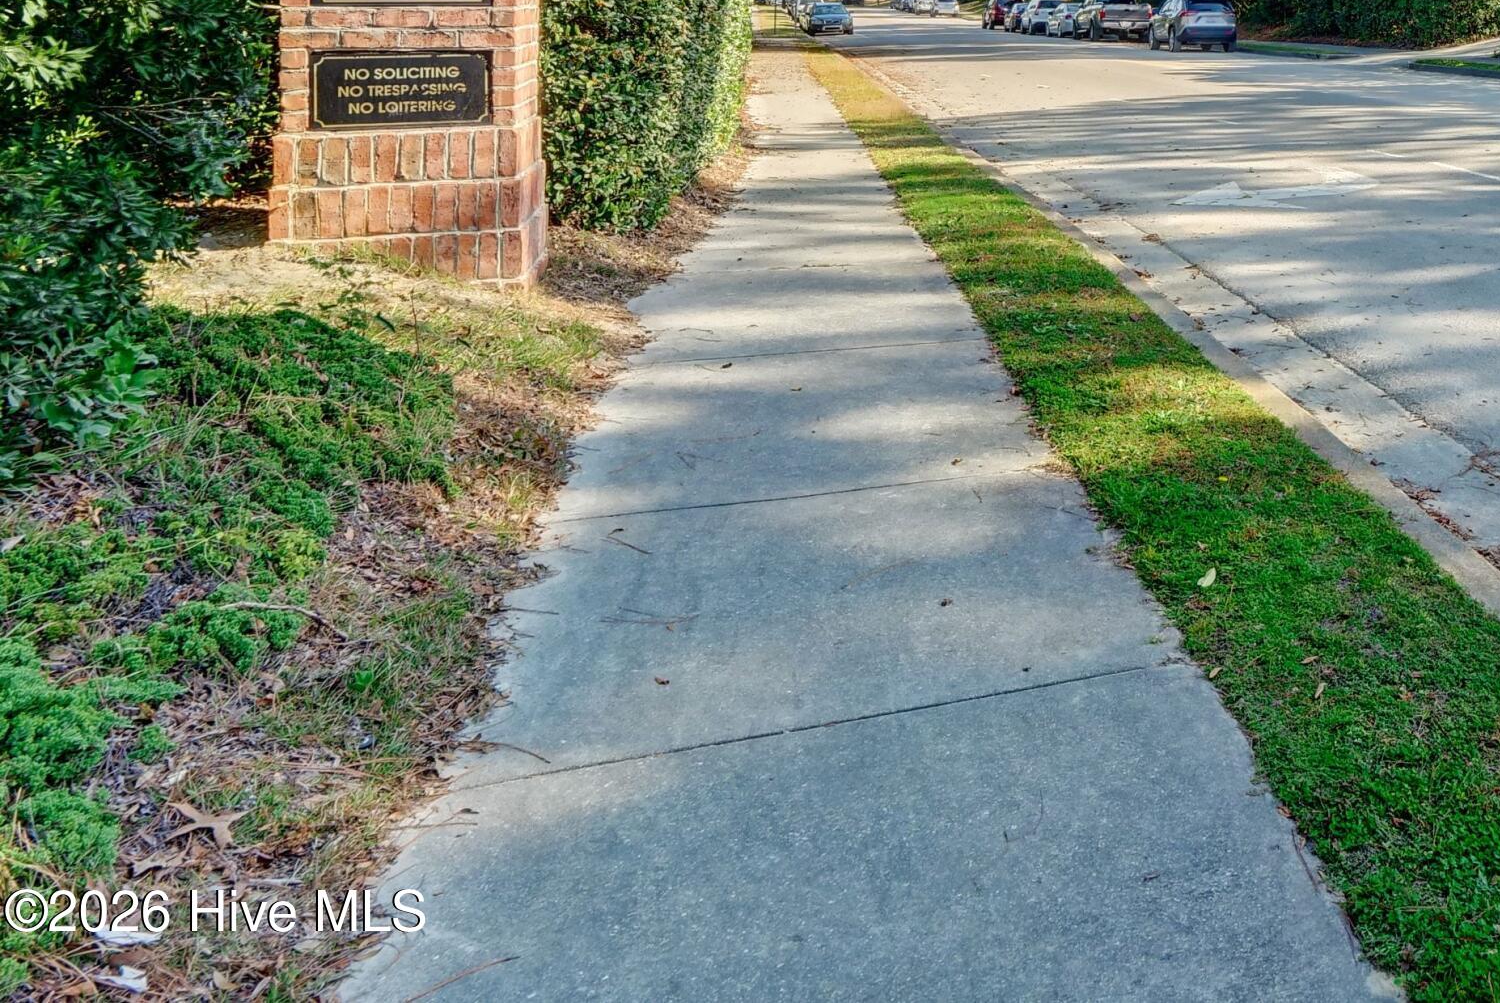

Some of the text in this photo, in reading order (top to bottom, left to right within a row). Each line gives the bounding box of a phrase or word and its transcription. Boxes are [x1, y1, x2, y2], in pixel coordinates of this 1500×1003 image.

[344, 66, 461, 81] NO SOLICITING
[337, 83, 467, 98] NO TRESPASSING
[348, 99, 456, 115] NO LOITERING
